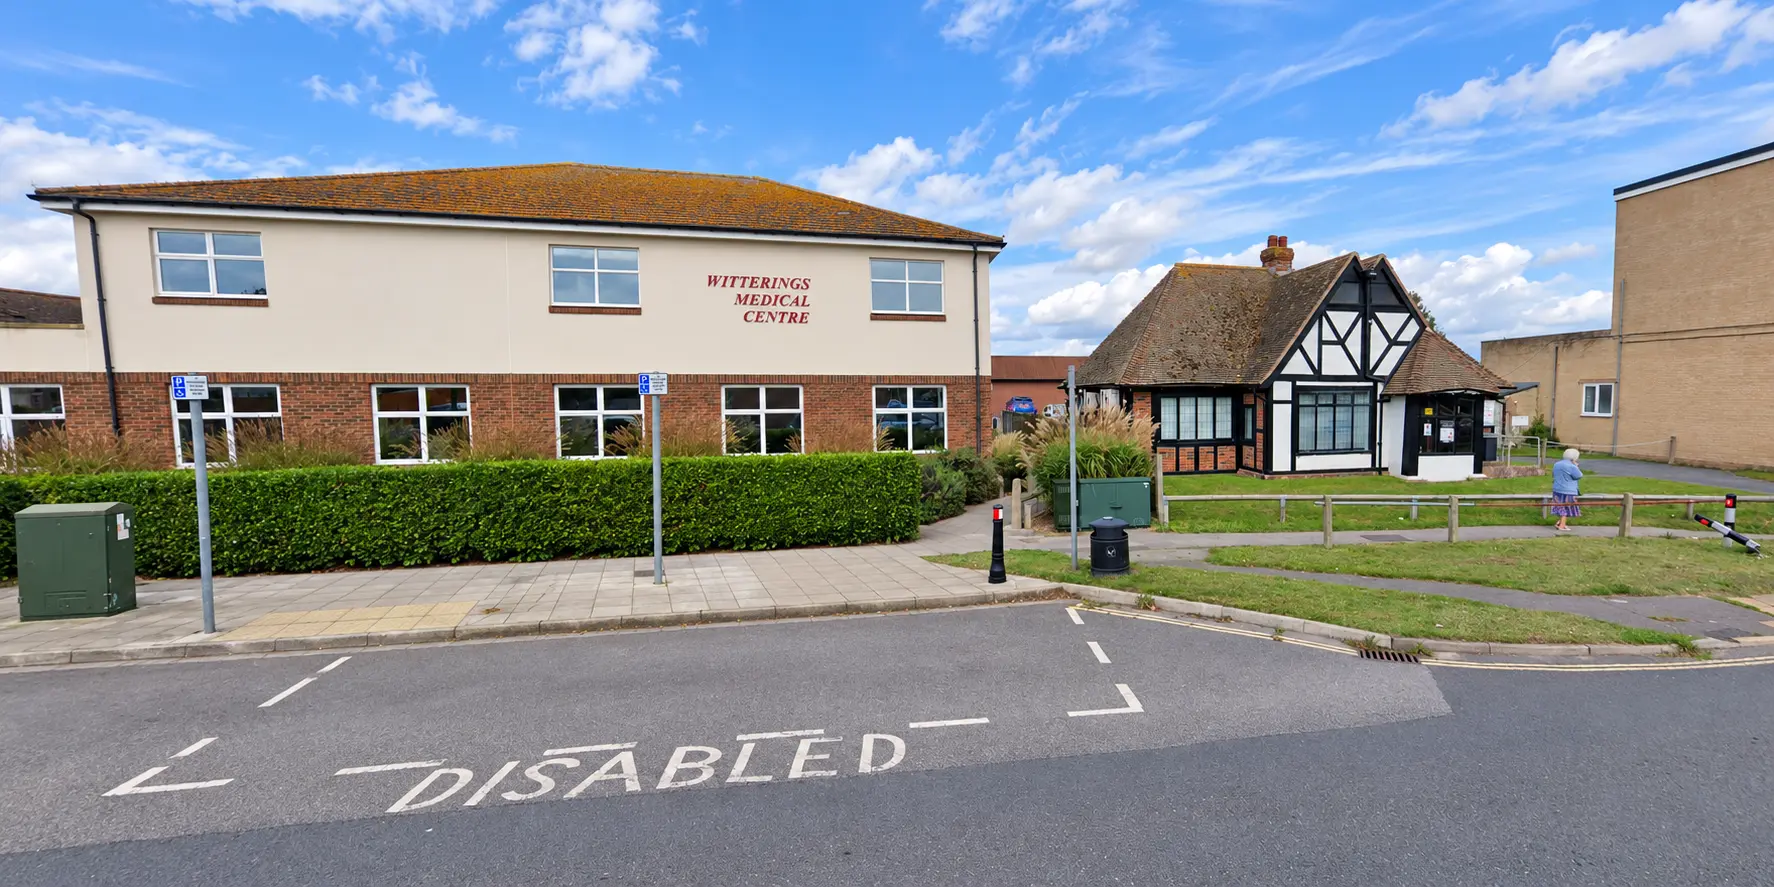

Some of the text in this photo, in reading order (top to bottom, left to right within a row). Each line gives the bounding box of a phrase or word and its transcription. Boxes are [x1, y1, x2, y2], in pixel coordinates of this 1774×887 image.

[707, 275, 811, 290] WITTERINGS
[734, 293, 811, 307] MEDICAL
[743, 310, 810, 324] CENTRE
[385, 733, 907, 813] DISABLED
